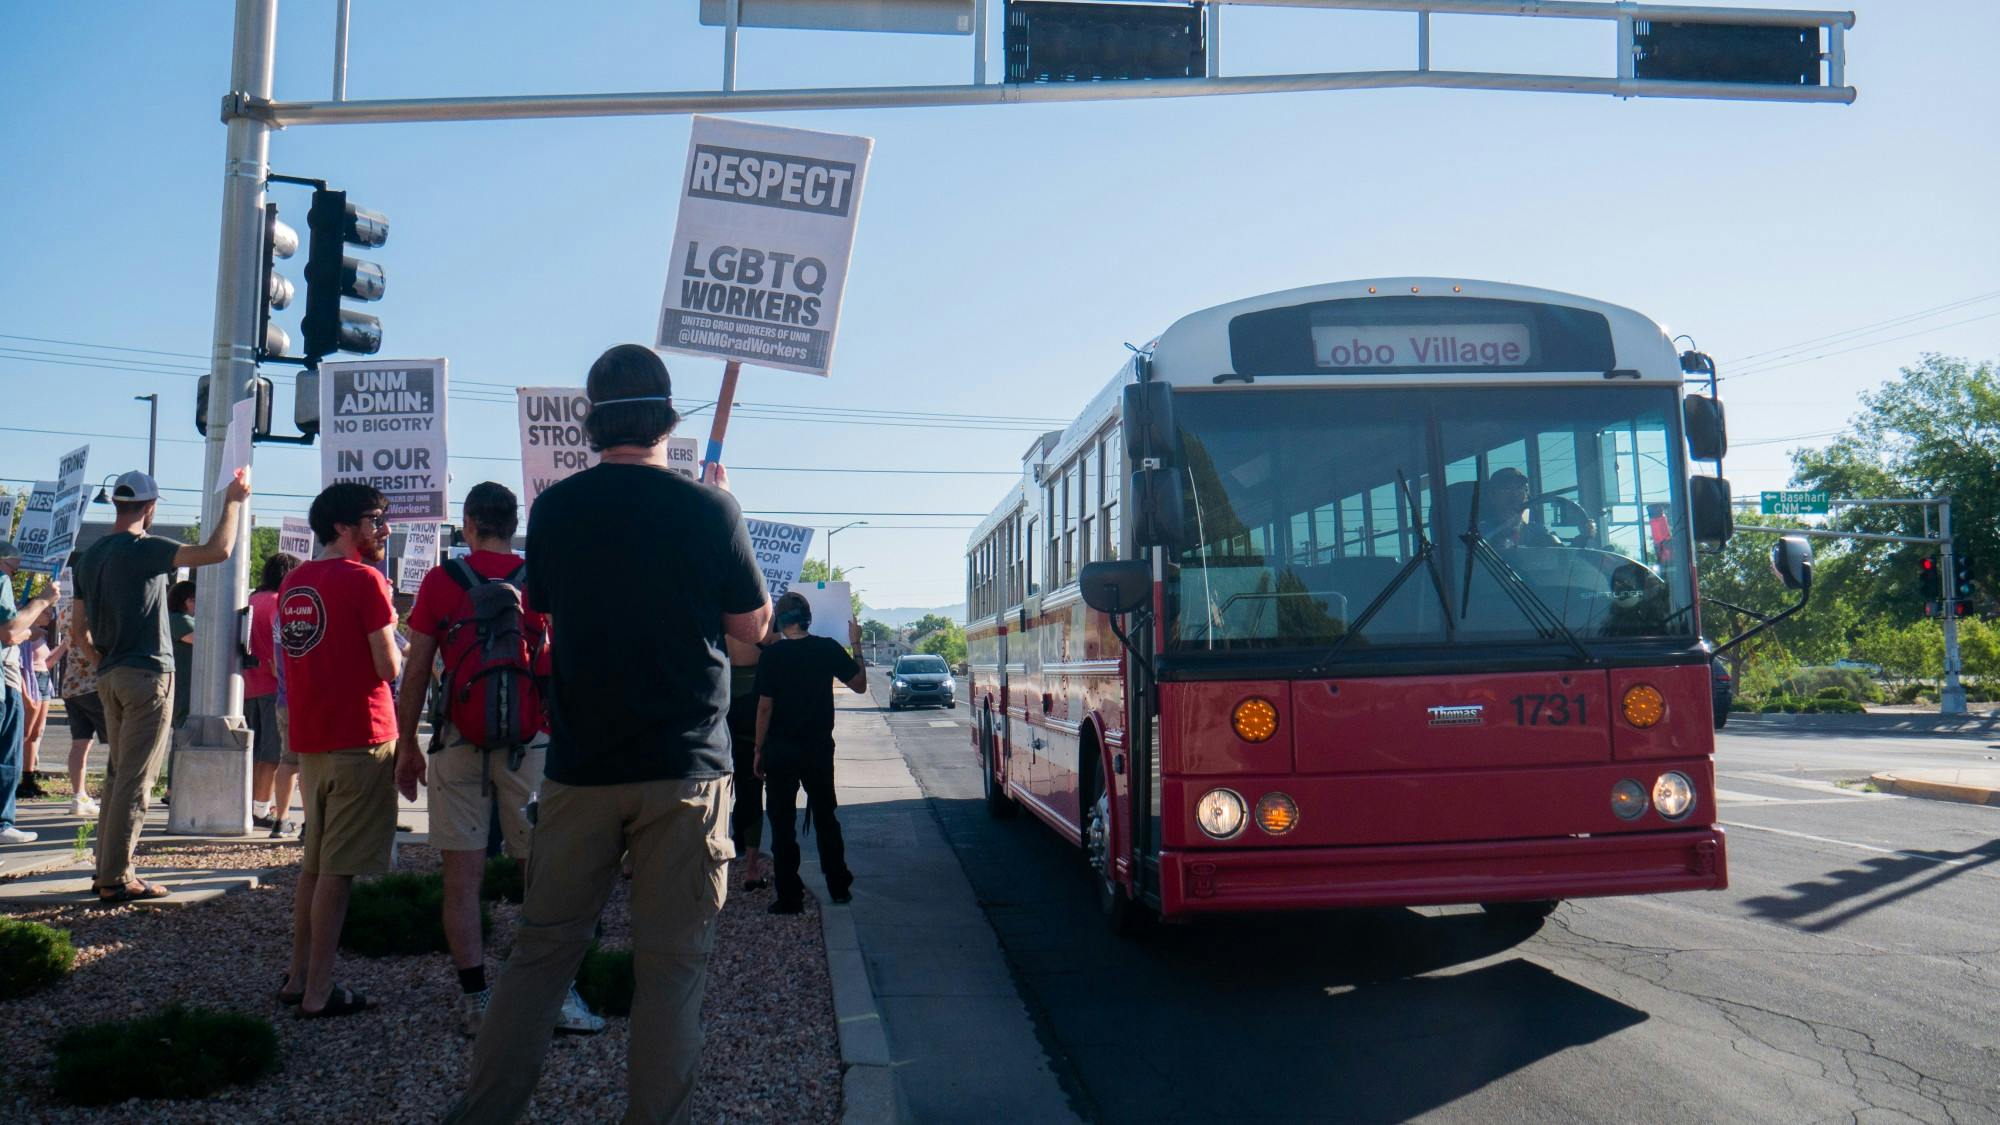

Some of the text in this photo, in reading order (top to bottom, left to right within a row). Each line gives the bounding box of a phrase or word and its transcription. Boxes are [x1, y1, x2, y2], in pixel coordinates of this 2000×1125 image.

[692, 151, 851, 209] RESPECT
[684, 241, 827, 296] LGBTQ
[681, 279, 821, 327] WORKERS
[681, 315, 811, 343] UNITED GRAD WORKERS OF UNM
[679, 328, 808, 360] @UNMGradWorkers
[1409, 336, 1521, 366] Village
[353, 371, 407, 392] UNM
[339, 391, 429, 414] ADMIN:
[526, 396, 588, 422] UNIO
[334, 417, 434, 433] NO BIGOTRY
[337, 448, 431, 472] IN OUR
[553, 450, 589, 470] FOR
[667, 447, 694, 462] KERS
[1780, 491, 1826, 503] Basehart
[1773, 502, 1799, 514] CNM
[20, 527, 49, 542] LGB
[411, 522, 437, 534] UNION
[747, 521, 807, 543] UNION
[18, 541, 47, 556] WORK
[281, 535, 310, 554] UNITED
[408, 533, 435, 544] STRONG
[751, 537, 802, 555] TRONG
[756, 551, 781, 564] FOR
[1429, 706, 1482, 719] Thomas
[1509, 693, 1587, 726] 1731
